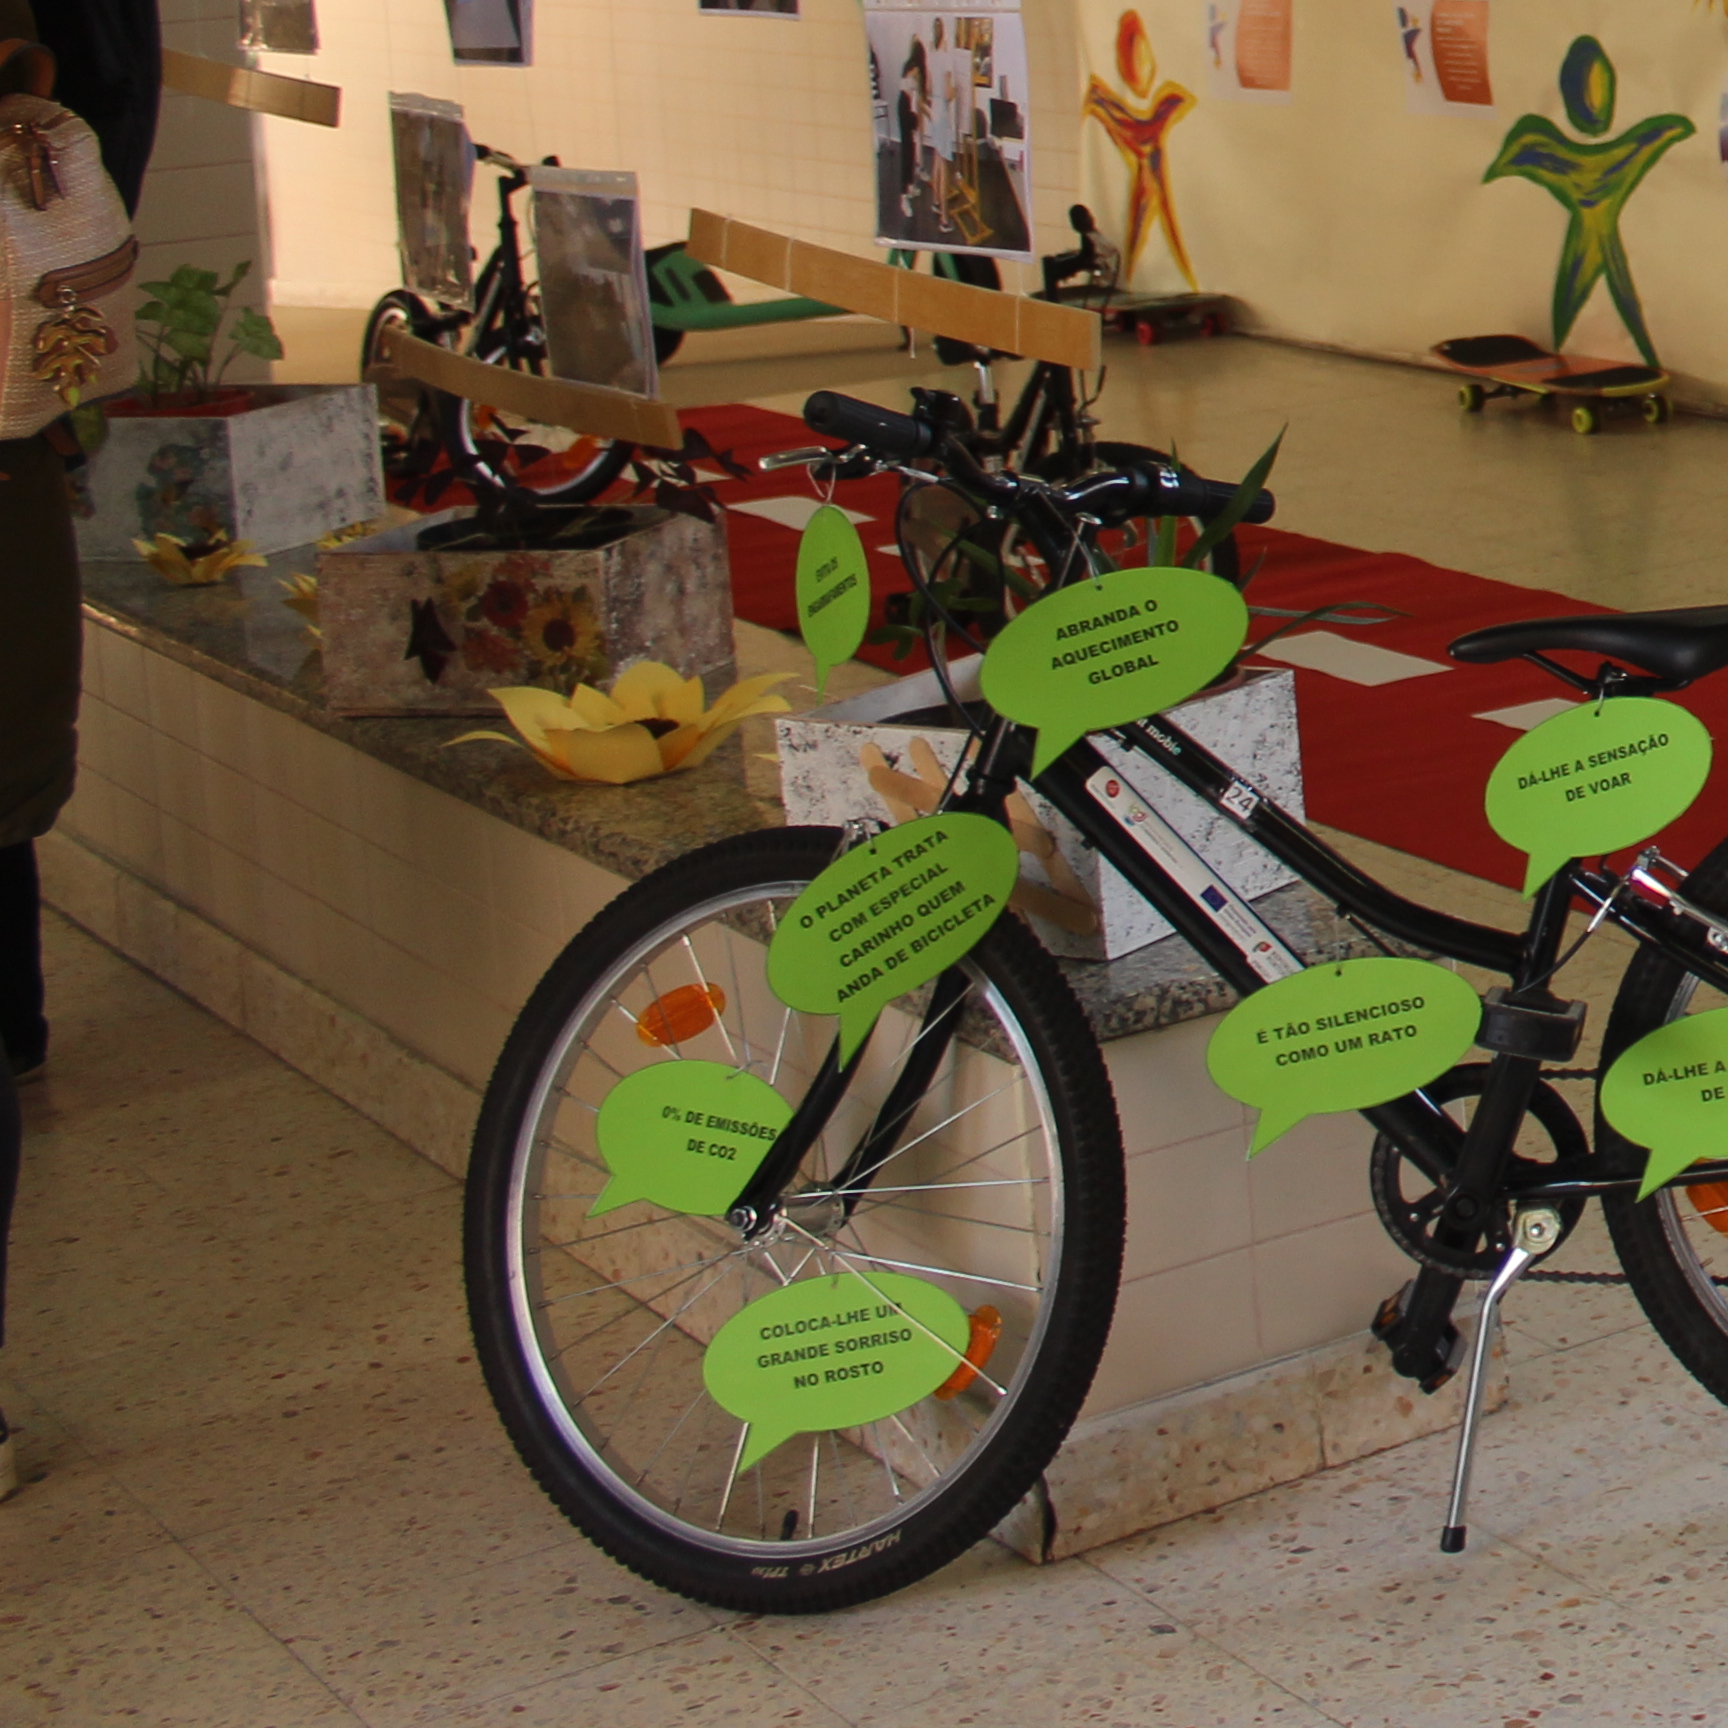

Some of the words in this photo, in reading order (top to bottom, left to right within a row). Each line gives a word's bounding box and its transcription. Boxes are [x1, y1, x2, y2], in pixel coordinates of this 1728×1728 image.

[1056, 605, 1141, 641] ABRANDA
[1144, 599, 1158, 613] O
[1051, 619, 1179, 670] AQUECIMENTO
[1088, 654, 1159, 685] GLOBAL
[1517, 763, 1571, 790] DÁ-LHE
[1575, 759, 1585, 773] A
[1587, 733, 1669, 768] SENSAÇÃO
[1226, 785, 1254, 812] 24
[1565, 785, 1586, 802] DE
[1588, 772, 1631, 795] VOAR
[800, 915, 813, 929] O
[815, 866, 893, 919] PLANETA
[891, 830, 949, 868] TRATA
[829, 912, 868, 942] COM
[869, 863, 949, 917] ESPECIAL
[839, 913, 915, 967] CARINHO
[916, 880, 965, 917] QUEM
[837, 967, 884, 1003] ANDA
[884, 948, 909, 971] DE
[909, 893, 996, 953] BICICLETA
[1256, 1031, 1269, 1044] É
[1273, 1021, 1311, 1040] TÃO
[1315, 996, 1425, 1031] SILENCIOSO
[1275, 1044, 1329, 1067] COMO
[1334, 1036, 1363, 1053] UM
[1367, 1024, 1417, 1046] RATO
[1642, 1062, 1709, 1086] DÁ-LHE
[1714, 1060, 1727, 1073] A
[1701, 1086, 1725, 1102] DE
[662, 1105, 681, 1121] 0%
[685, 1110, 704, 1125] DE
[705, 1114, 778, 1141] EMISSÕES
[687, 1138, 706, 1154] DE
[708, 1143, 737, 1161] CO2
[760, 1308, 871, 1340] COLOCA-LHE
[875, 1302, 903, 1319] UM
[757, 1343, 830, 1369] GRANDE
[834, 1328, 912, 1354] SORRISO
[793, 1373, 819, 1389] NO
[824, 1361, 884, 1383] ROSTO
[817, 1529, 902, 1574] HARTEX
